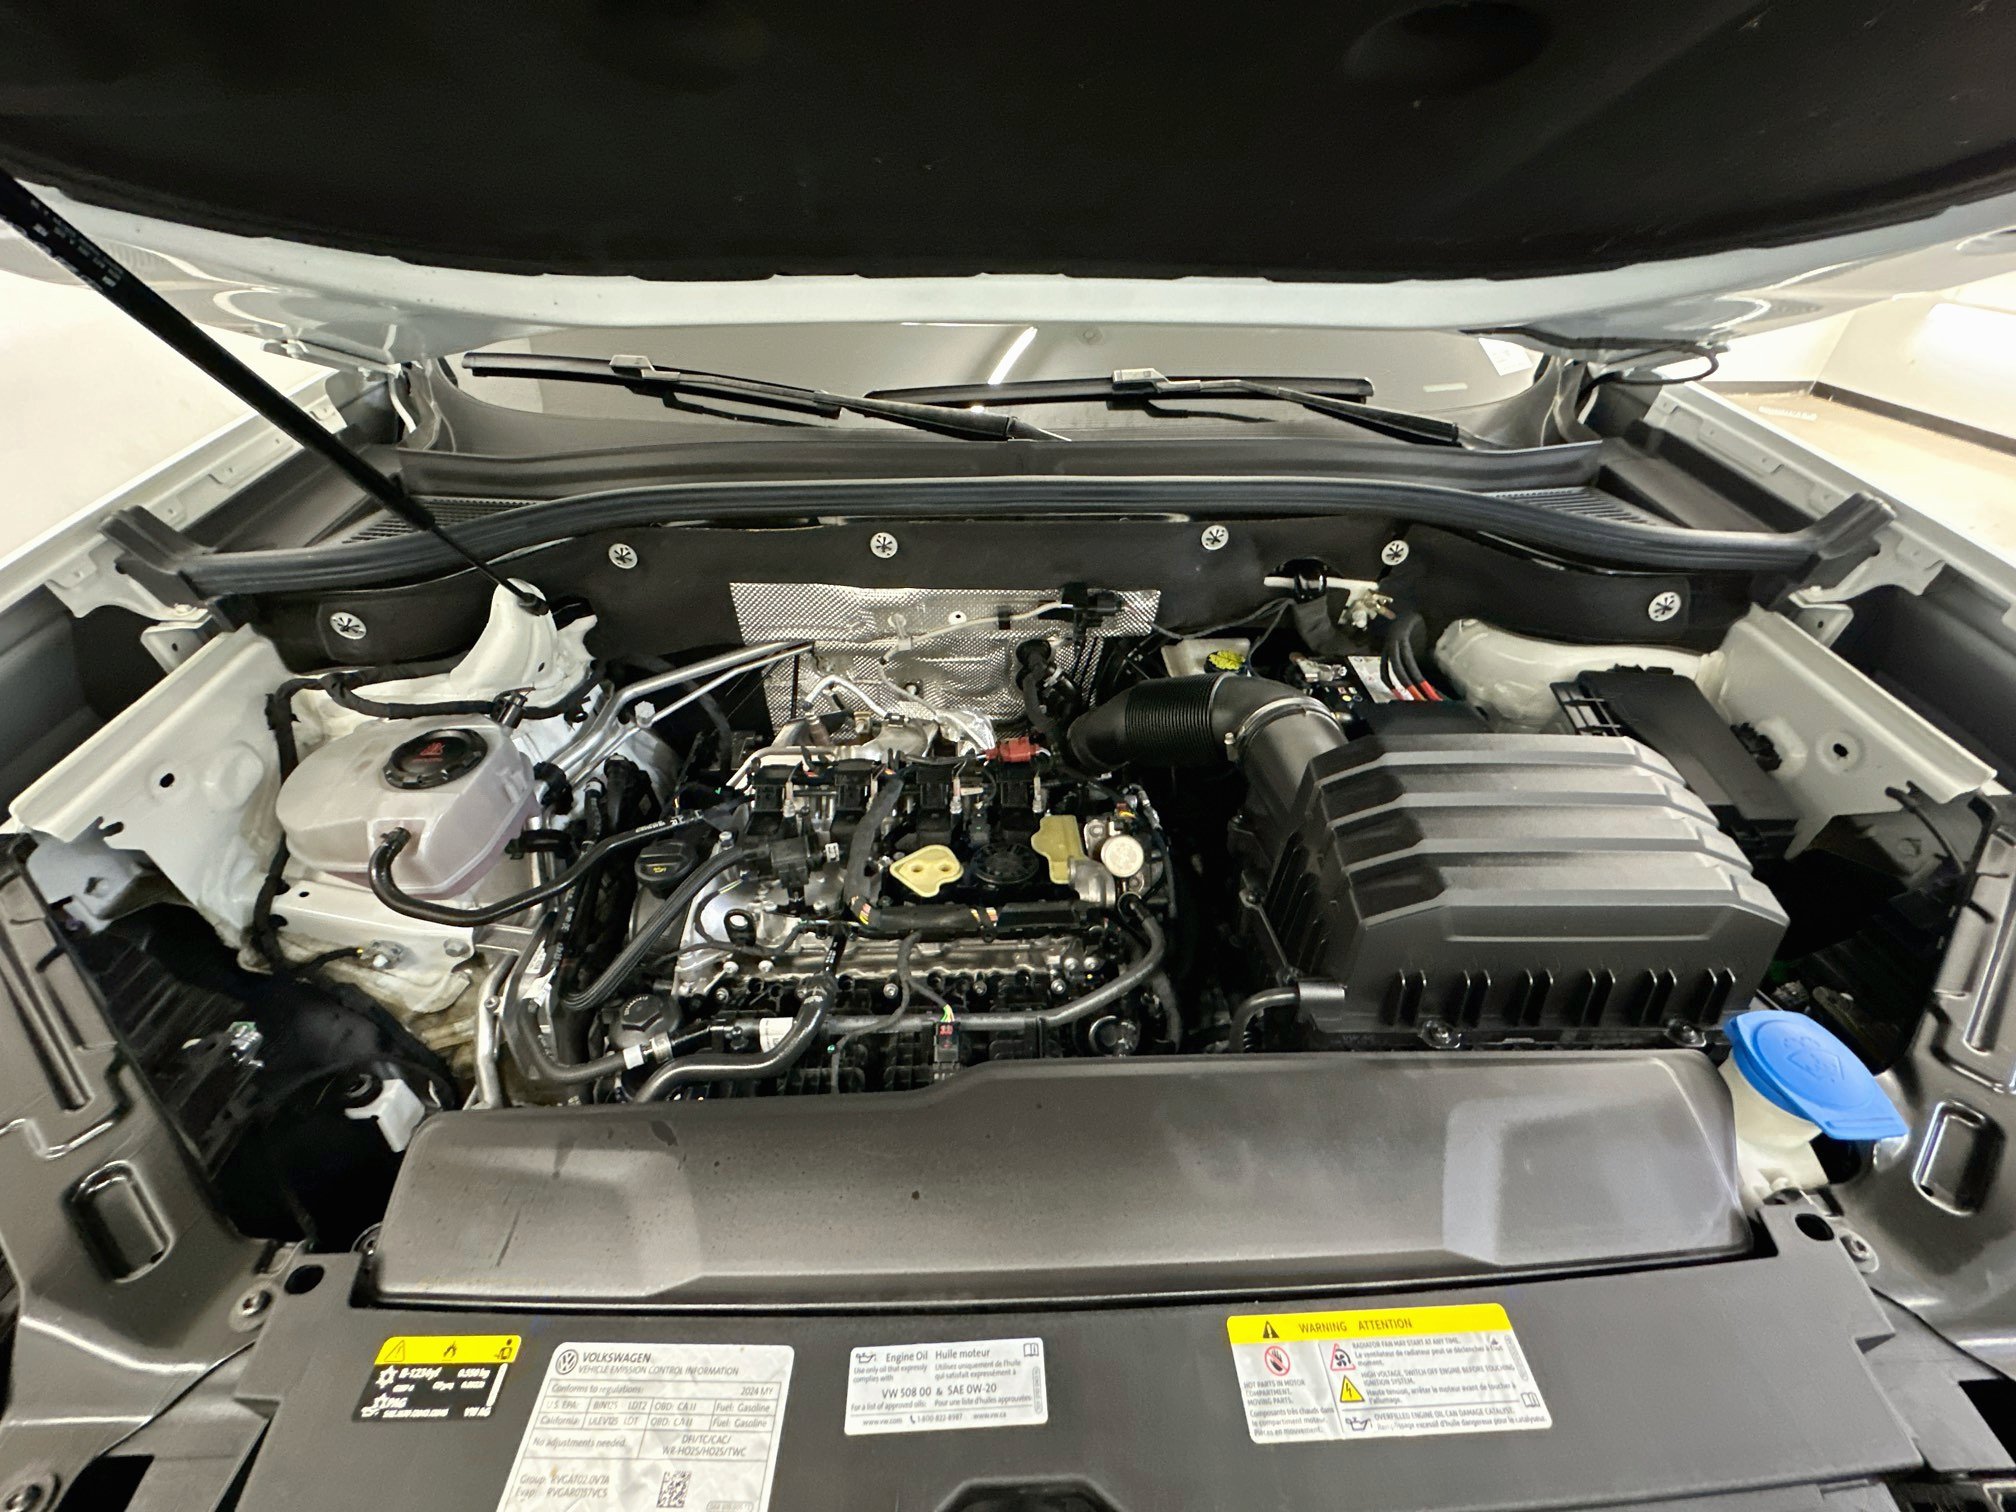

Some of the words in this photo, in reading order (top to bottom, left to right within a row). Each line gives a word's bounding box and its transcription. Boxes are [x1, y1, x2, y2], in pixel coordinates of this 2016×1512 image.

[1298, 1322, 1347, 1333] WARNING
[1358, 1318, 1412, 1330] ATTENTION
[1352, 1341, 1380, 1349] RADIATOR
[1381, 1340, 1393, 1348] FAN
[1394, 1340, 1406, 1348] MAY
[1424, 1338, 1432, 1346] AT
[936, 1350, 958, 1359] Huile
[960, 1348, 990, 1358] moteur
[1364, 1350, 1396, 1358] ventilateur
[1404, 1348, 1430, 1356] radiateur
[1454, 1345, 1484, 1353] déclencher
[583, 1352, 652, 1363] VOLKSWAGEN
[886, 1353, 914, 1364] Engine
[916, 1351, 928, 1360] Oil
[935, 1362, 957, 1370] Utilisez
[958, 1361, 994, 1370] uniquement
[995, 1360, 1002, 1368] de
[1004, 1358, 1021, 1367] l'huile
[578, 1366, 611, 1374] VEHICLE
[611, 1366, 646, 1374] EMISSION
[648, 1366, 682, 1374] CONTROL
[685, 1366, 739, 1376] INFORMATION
[866, 1366, 878, 1375] only
[900, 1364, 928, 1374] expressly
[935, 1372, 944, 1381] qui
[970, 1369, 1011, 1378] expressément
[1012, 1368, 1016, 1376] à
[1462, 1366, 1485, 1374] BEFORE
[853, 1376, 879, 1384] complies
[880, 1374, 894, 1382] with
[1244, 1381, 1256, 1389] HOT
[1258, 1380, 1276, 1388] PARTS
[1284, 1379, 1306, 1387] MOTOR
[552, 1384, 588, 1393] Conforms
[589, 1384, 598, 1392] to
[740, 1386, 759, 1396] 2024
[760, 1387, 773, 1396] MY
[882, 1389, 898, 1398] VW
[900, 1388, 917, 1398] 508
[920, 1387, 932, 1396] 00
[936, 1388, 942, 1396] &
[948, 1384, 964, 1396] SAE
[966, 1383, 997, 1394] 0W-20
[1462, 1384, 1478, 1392] avant
[974, 1396, 997, 1404] d'huiles
[1247, 1398, 1272, 1406] MOVING
[628, 1402, 648, 1410] LDT2
[654, 1402, 672, 1411] OBD:
[716, 1402, 734, 1412] Fuel:
[738, 1403, 770, 1412] Gasoline
[877, 1402, 884, 1410] of
[885, 1401, 913, 1410] approved
[1250, 1409, 1286, 1418] Composants
[1287, 1407, 1298, 1415] très
[1299, 1406, 1320, 1414] chauds
[1321, 1406, 1334, 1414] dans
[1374, 1412, 1410, 1420] OVERFILLED
[1458, 1408, 1484, 1416] DAMAGE
[540, 1416, 579, 1426] California:
[624, 1416, 640, 1426] LDT
[650, 1417, 670, 1426] OBD:
[712, 1418, 730, 1427] Fuel:
[734, 1418, 767, 1428] Gasoline
[863, 1418, 902, 1426] www.vw.com
[1440, 1418, 1461, 1427] d'huile
[1462, 1418, 1492, 1427] dangereux
[1494, 1418, 1508, 1426] pour
[1275, 1428, 1282, 1436] en
[533, 1438, 544, 1446] No
[546, 1438, 594, 1449] adjustments
[596, 1438, 627, 1448] needed.
